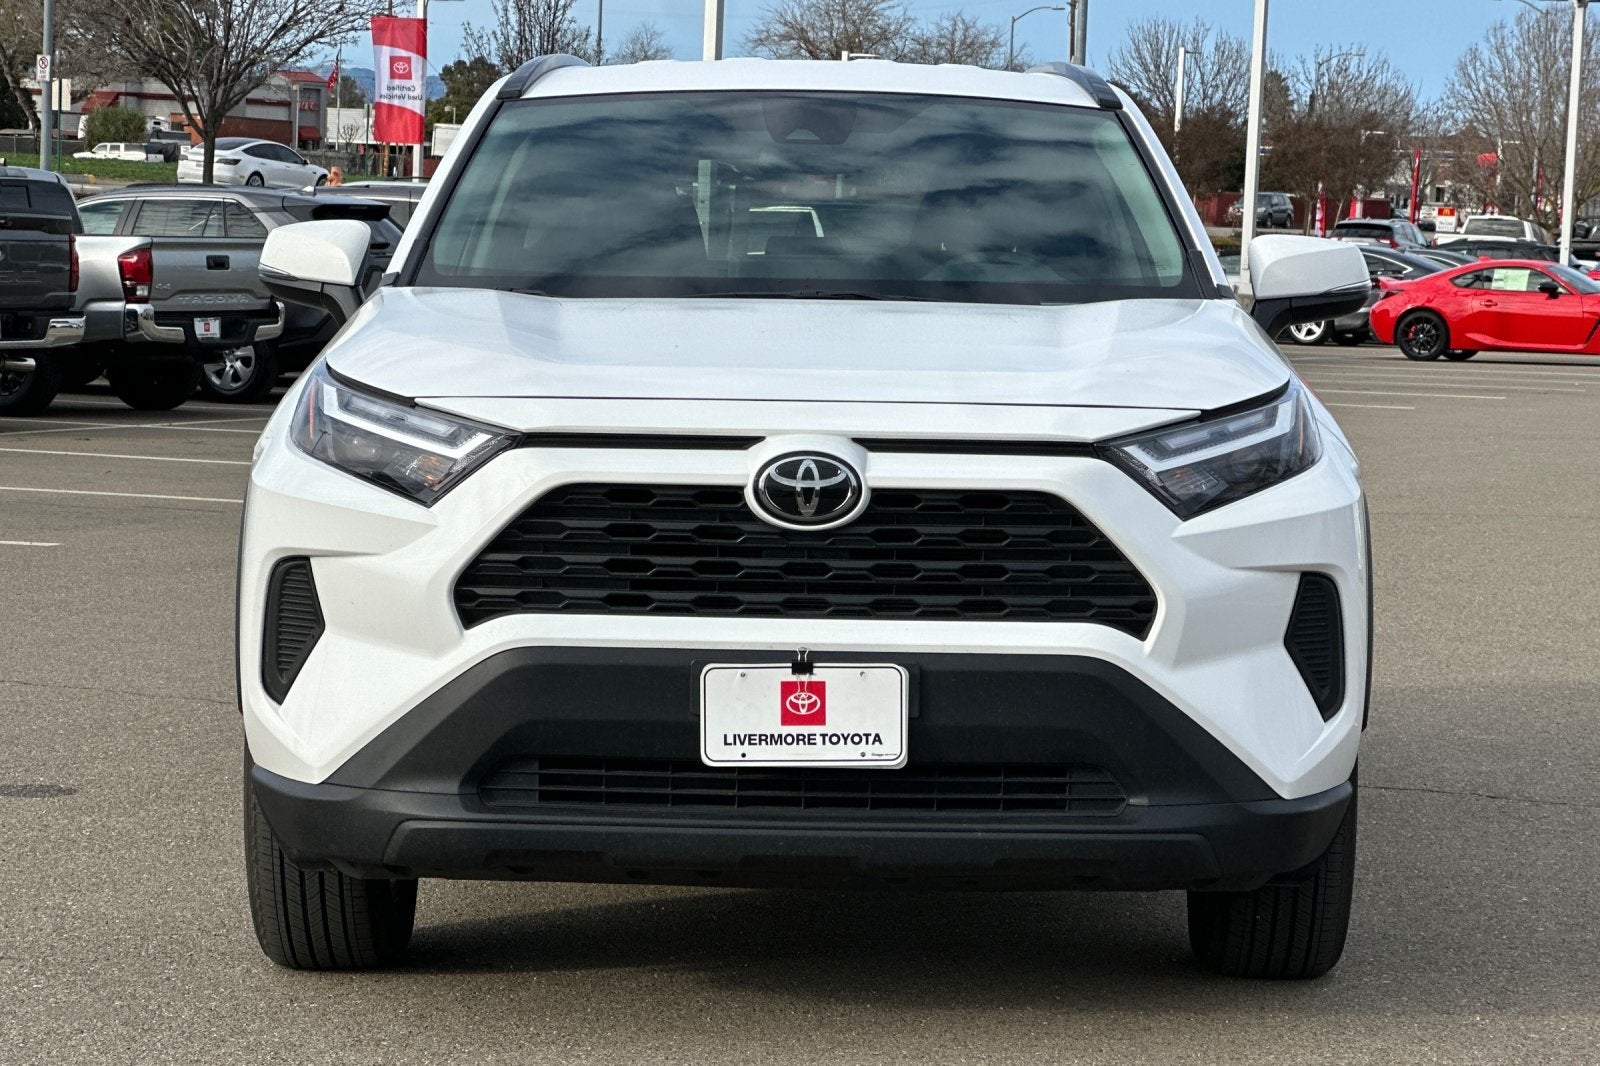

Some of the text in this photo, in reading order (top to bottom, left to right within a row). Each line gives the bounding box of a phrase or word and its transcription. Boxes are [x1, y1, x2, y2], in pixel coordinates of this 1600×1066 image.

[177, 295, 249, 304] TACOMA
[723, 733, 883, 747] LIVERMORE TOYOTA
